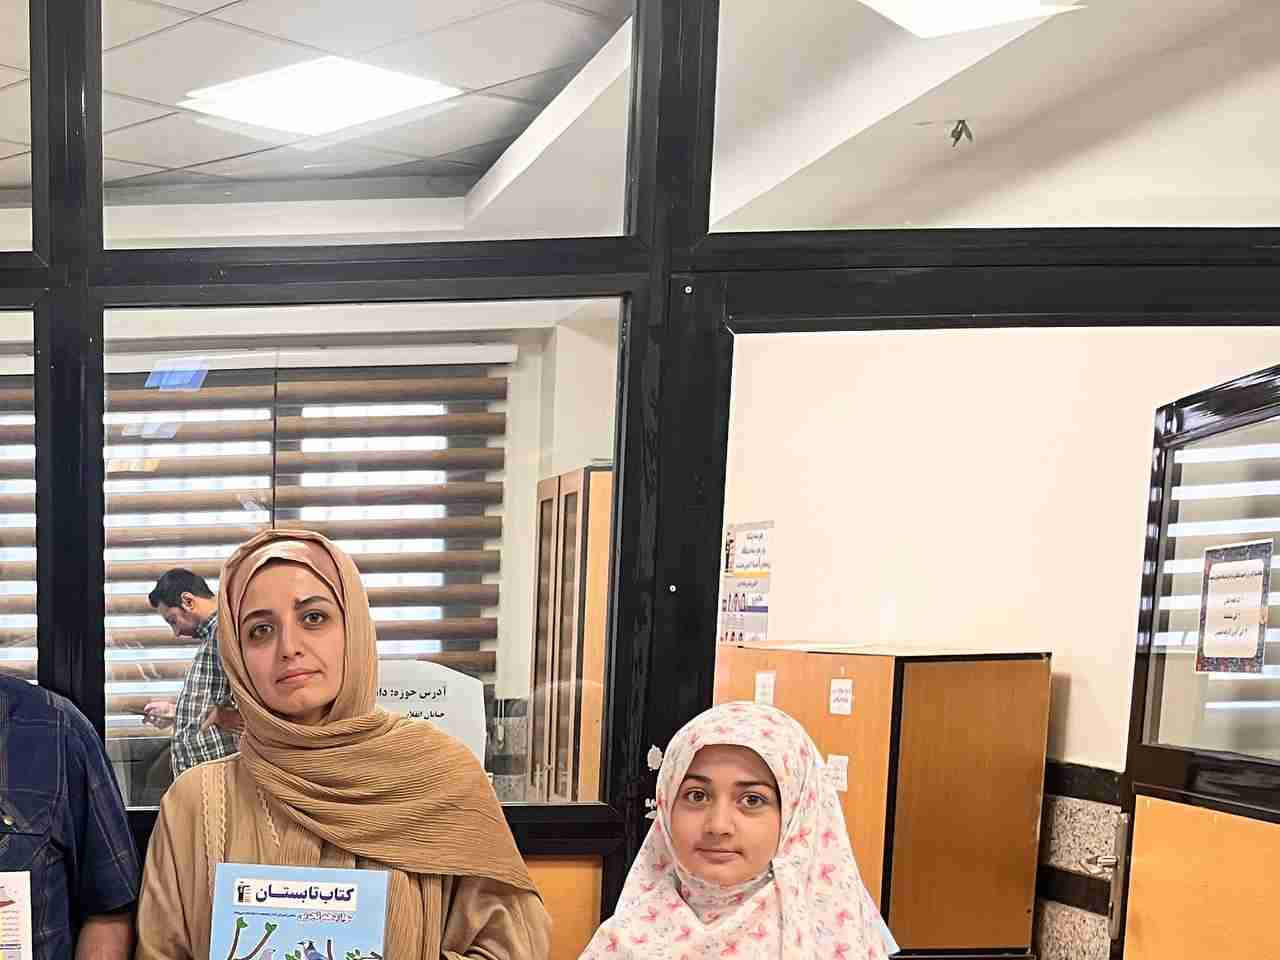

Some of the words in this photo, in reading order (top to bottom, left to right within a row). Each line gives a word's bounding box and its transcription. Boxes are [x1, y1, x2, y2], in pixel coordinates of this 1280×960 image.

[389, 687, 417, 699] حوزه:
[418, 683, 447, 699] آدرس
[407, 710, 423, 718] انقلا
[255, 884, 320, 903] تابستان
[319, 887, 355, 904] کتاب
